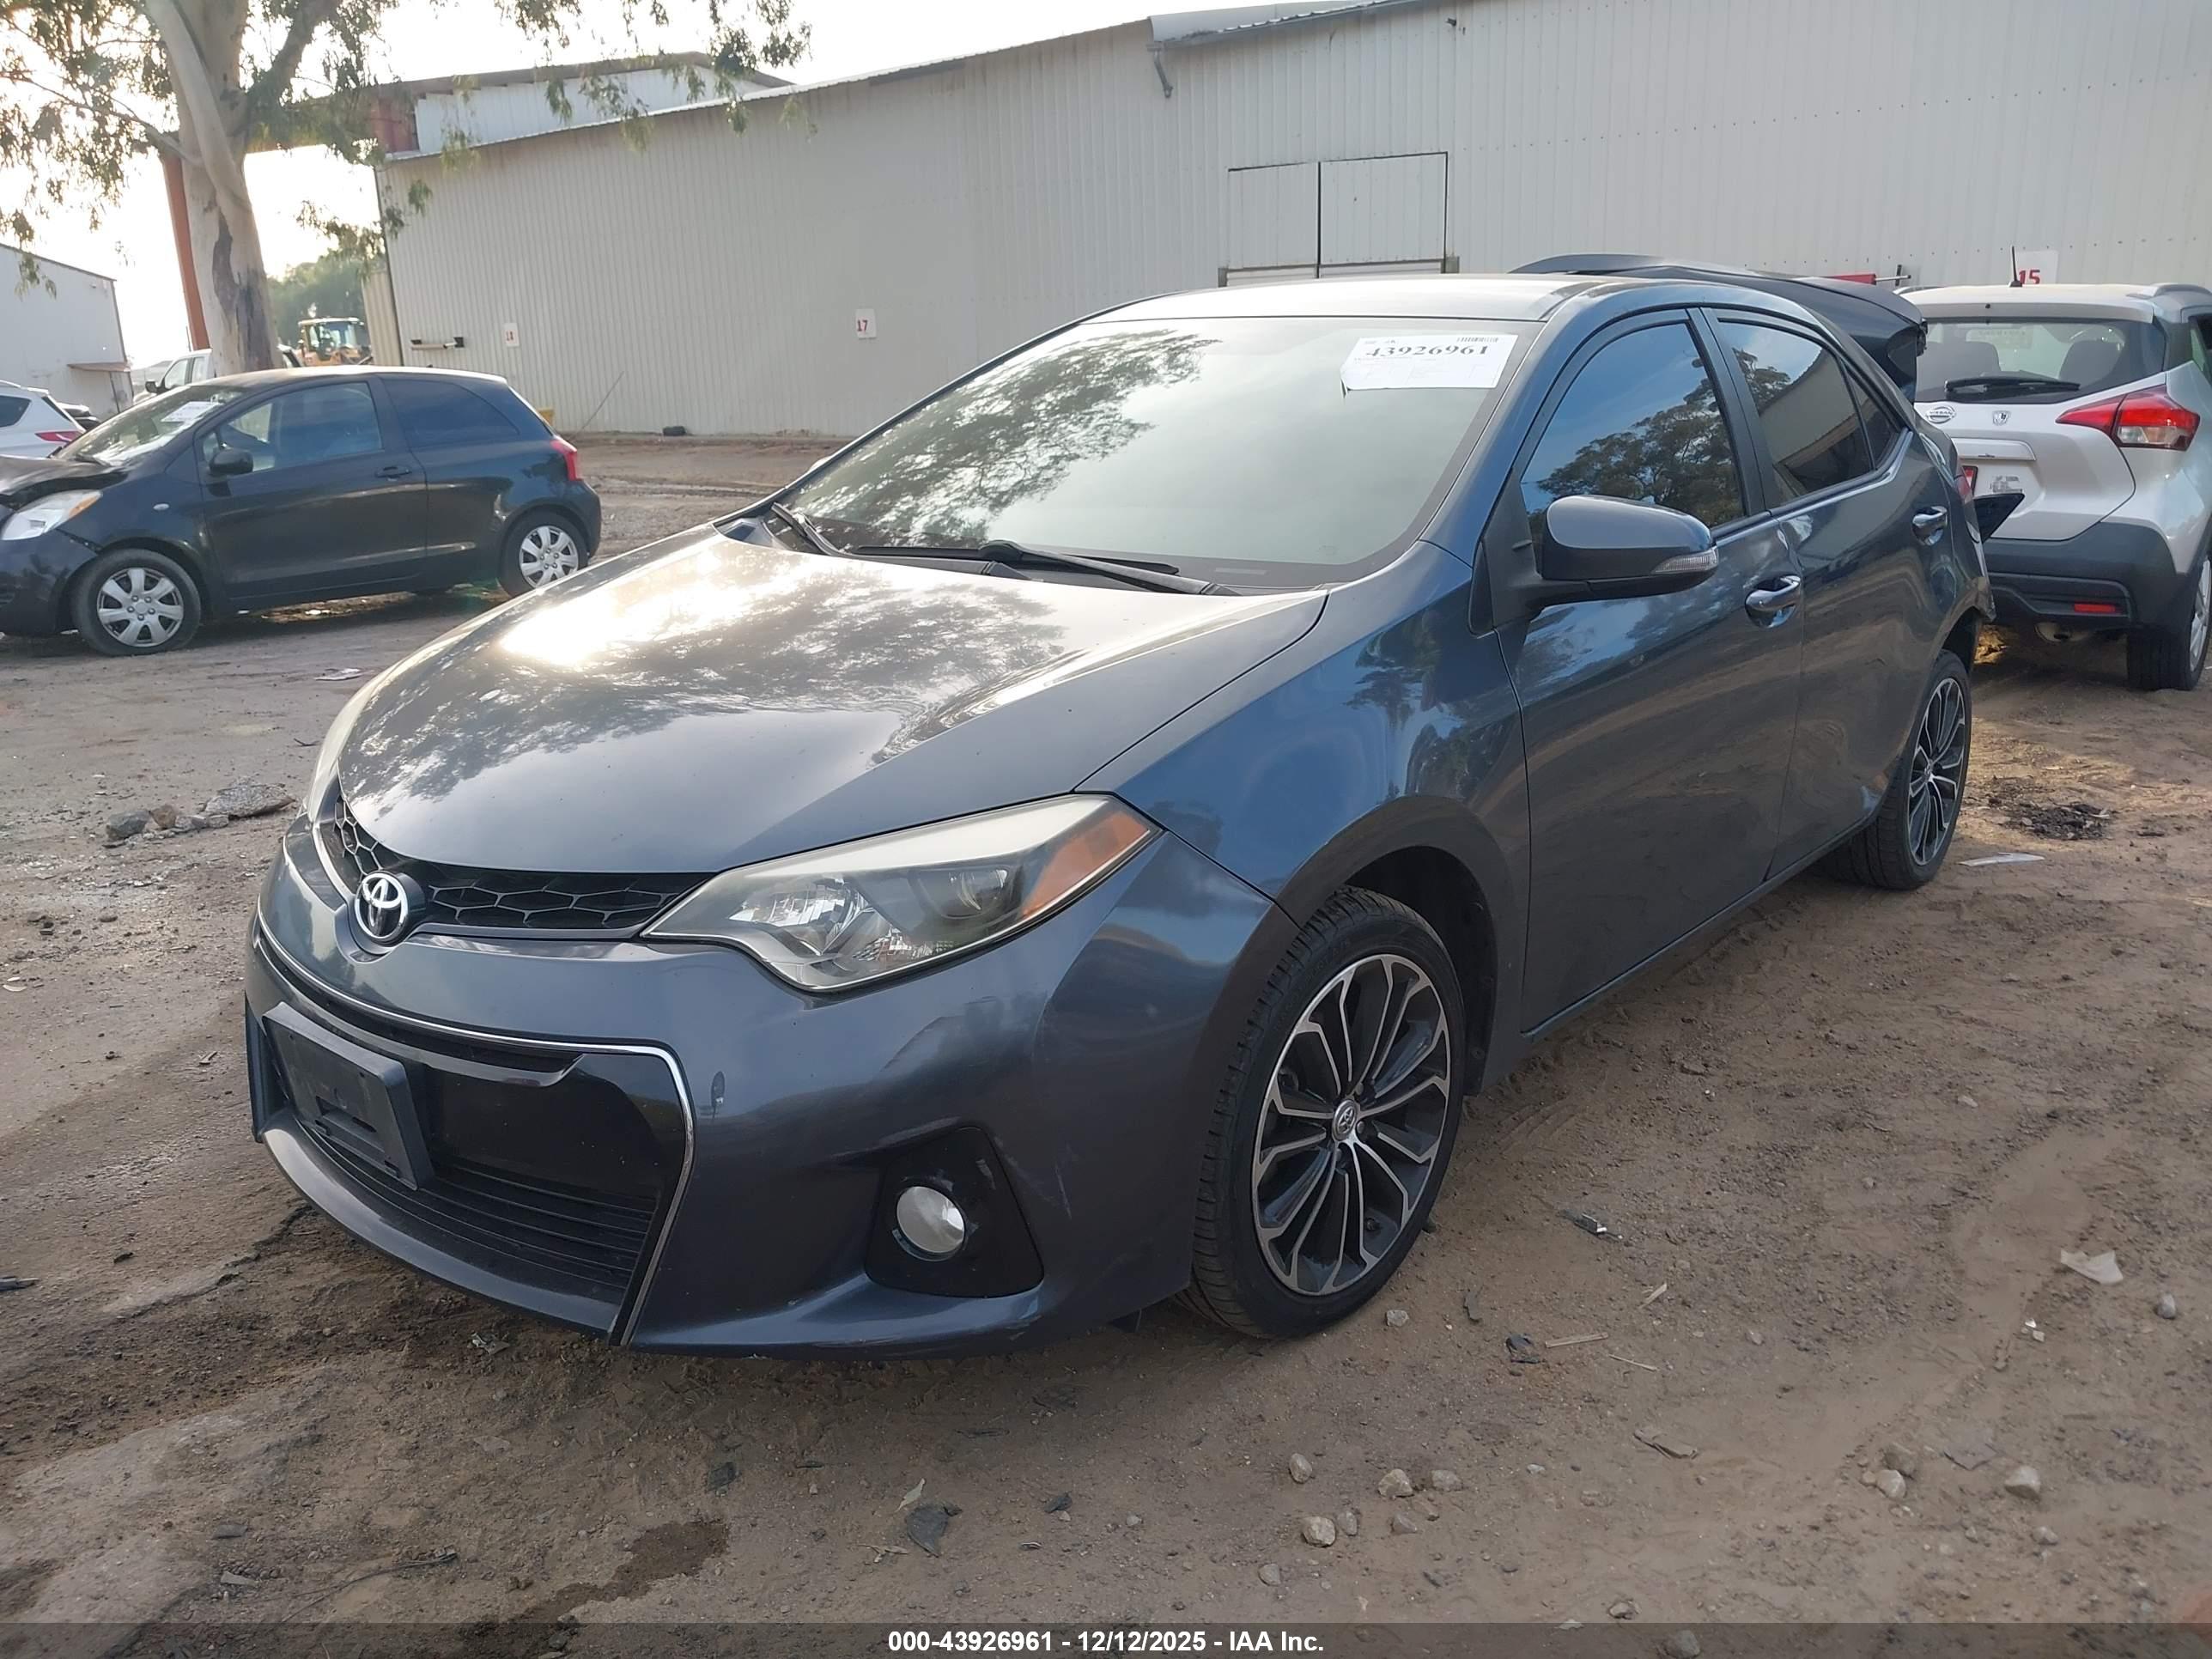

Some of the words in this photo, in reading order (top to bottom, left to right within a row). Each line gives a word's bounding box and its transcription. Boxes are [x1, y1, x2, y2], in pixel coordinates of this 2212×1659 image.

[2019, 269, 2040, 284] 15
[857, 319, 868, 331] 17
[1365, 345, 1488, 357] 43926961
